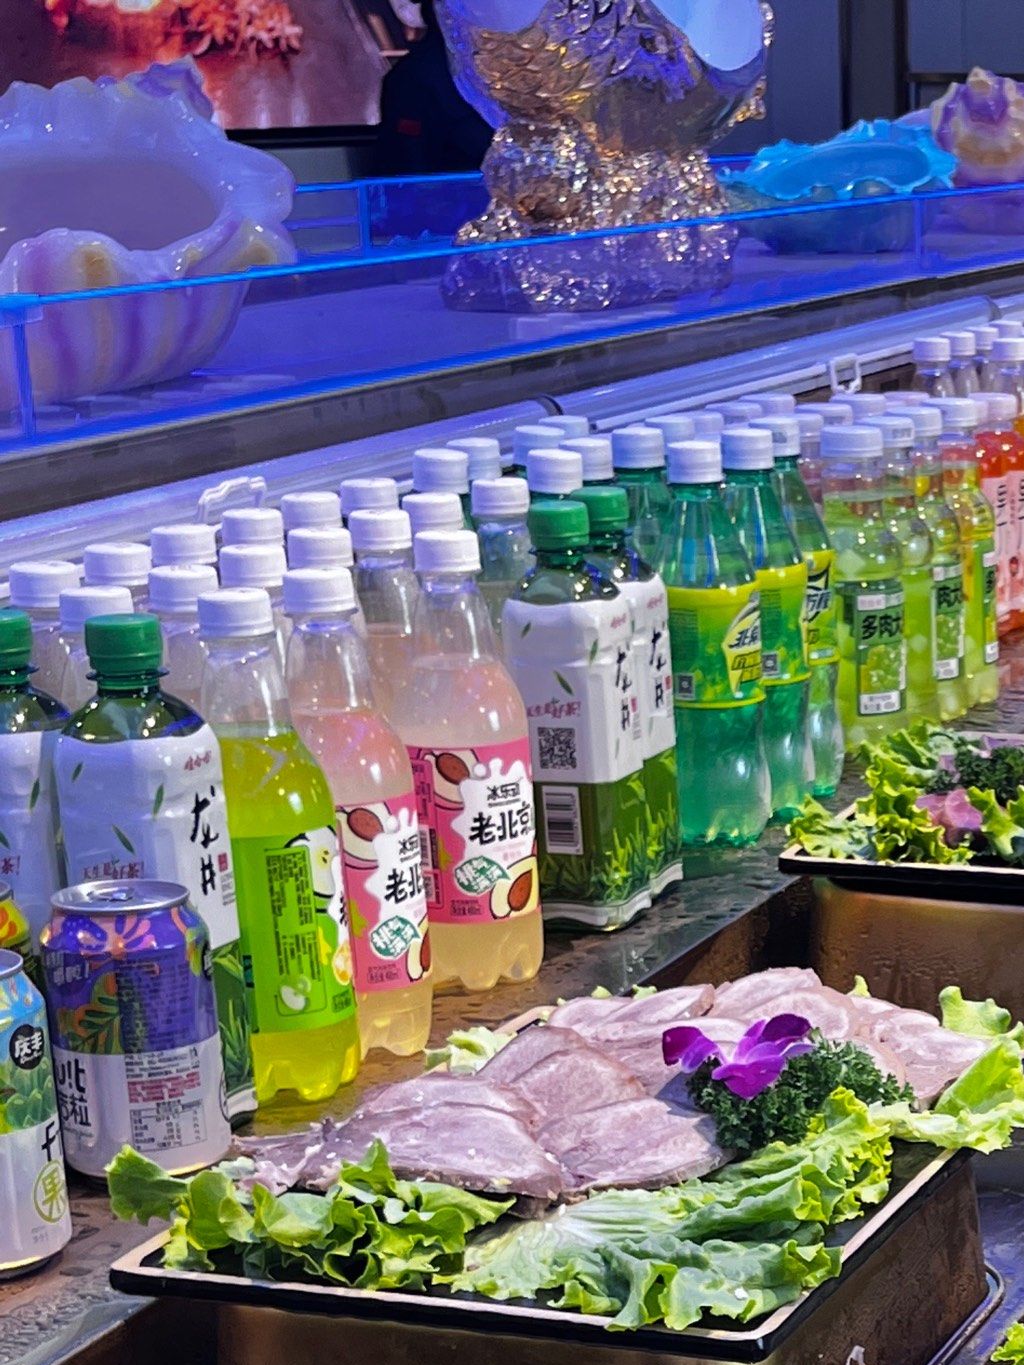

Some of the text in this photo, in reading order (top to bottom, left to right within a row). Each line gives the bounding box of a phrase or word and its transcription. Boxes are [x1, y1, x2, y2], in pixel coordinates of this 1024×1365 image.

[189, 785, 220, 896] 龙井
[469, 801, 531, 845] 老北京
[42, 1166, 65, 1217] 果
